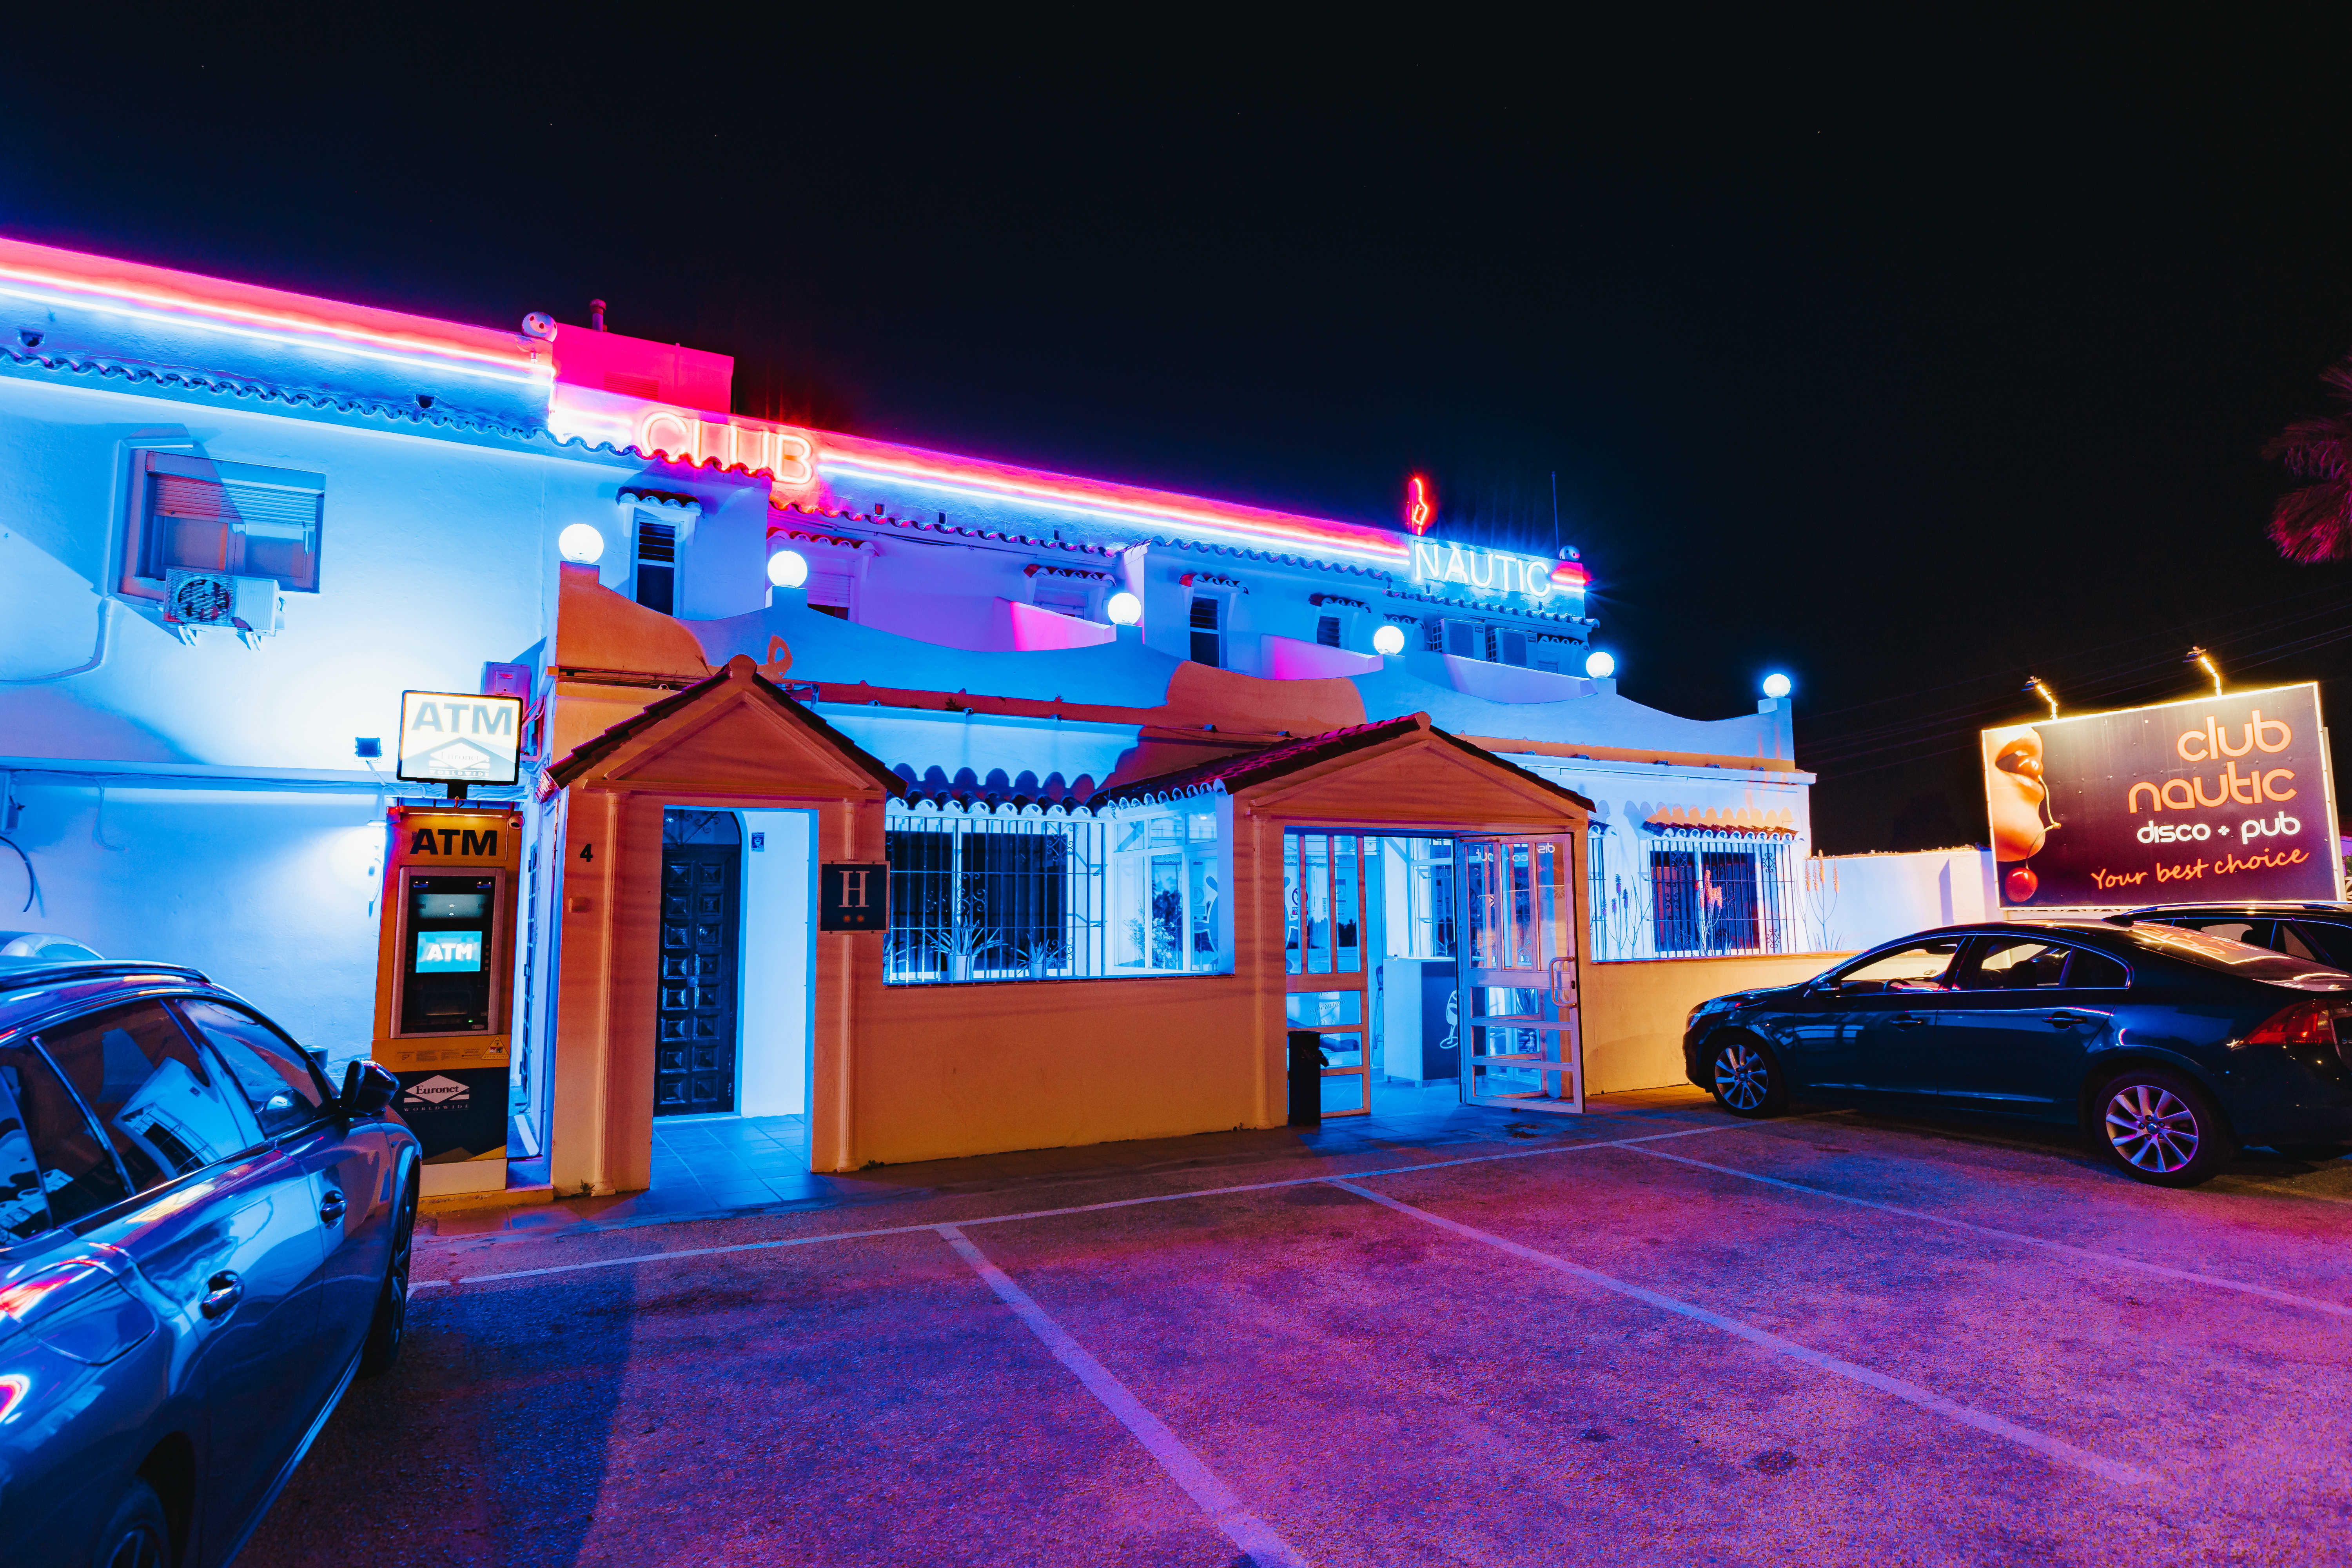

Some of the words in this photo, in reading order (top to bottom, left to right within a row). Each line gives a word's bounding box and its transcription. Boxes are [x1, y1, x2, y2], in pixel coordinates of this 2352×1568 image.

[641, 412, 813, 484] CLUB
[1414, 541, 1551, 597] NAUTIC
[411, 701, 513, 735] ATM
[2177, 710, 2292, 762] club
[441, 751, 479, 760] Euronet
[2129, 761, 2298, 813] nautic
[410, 828, 497, 857] ATM
[2137, 820, 2211, 844] disco
[2241, 811, 2301, 844] pub
[580, 844, 593, 862] 4
[2091, 868, 2147, 889] Your
[2156, 858, 2209, 882] best
[2214, 848, 2309, 875] choice
[838, 871, 870, 907] H
[426, 944, 472, 960] ATM
[1309, 993, 1346, 1023] esperando
[415, 1085, 460, 1094] Euronet
